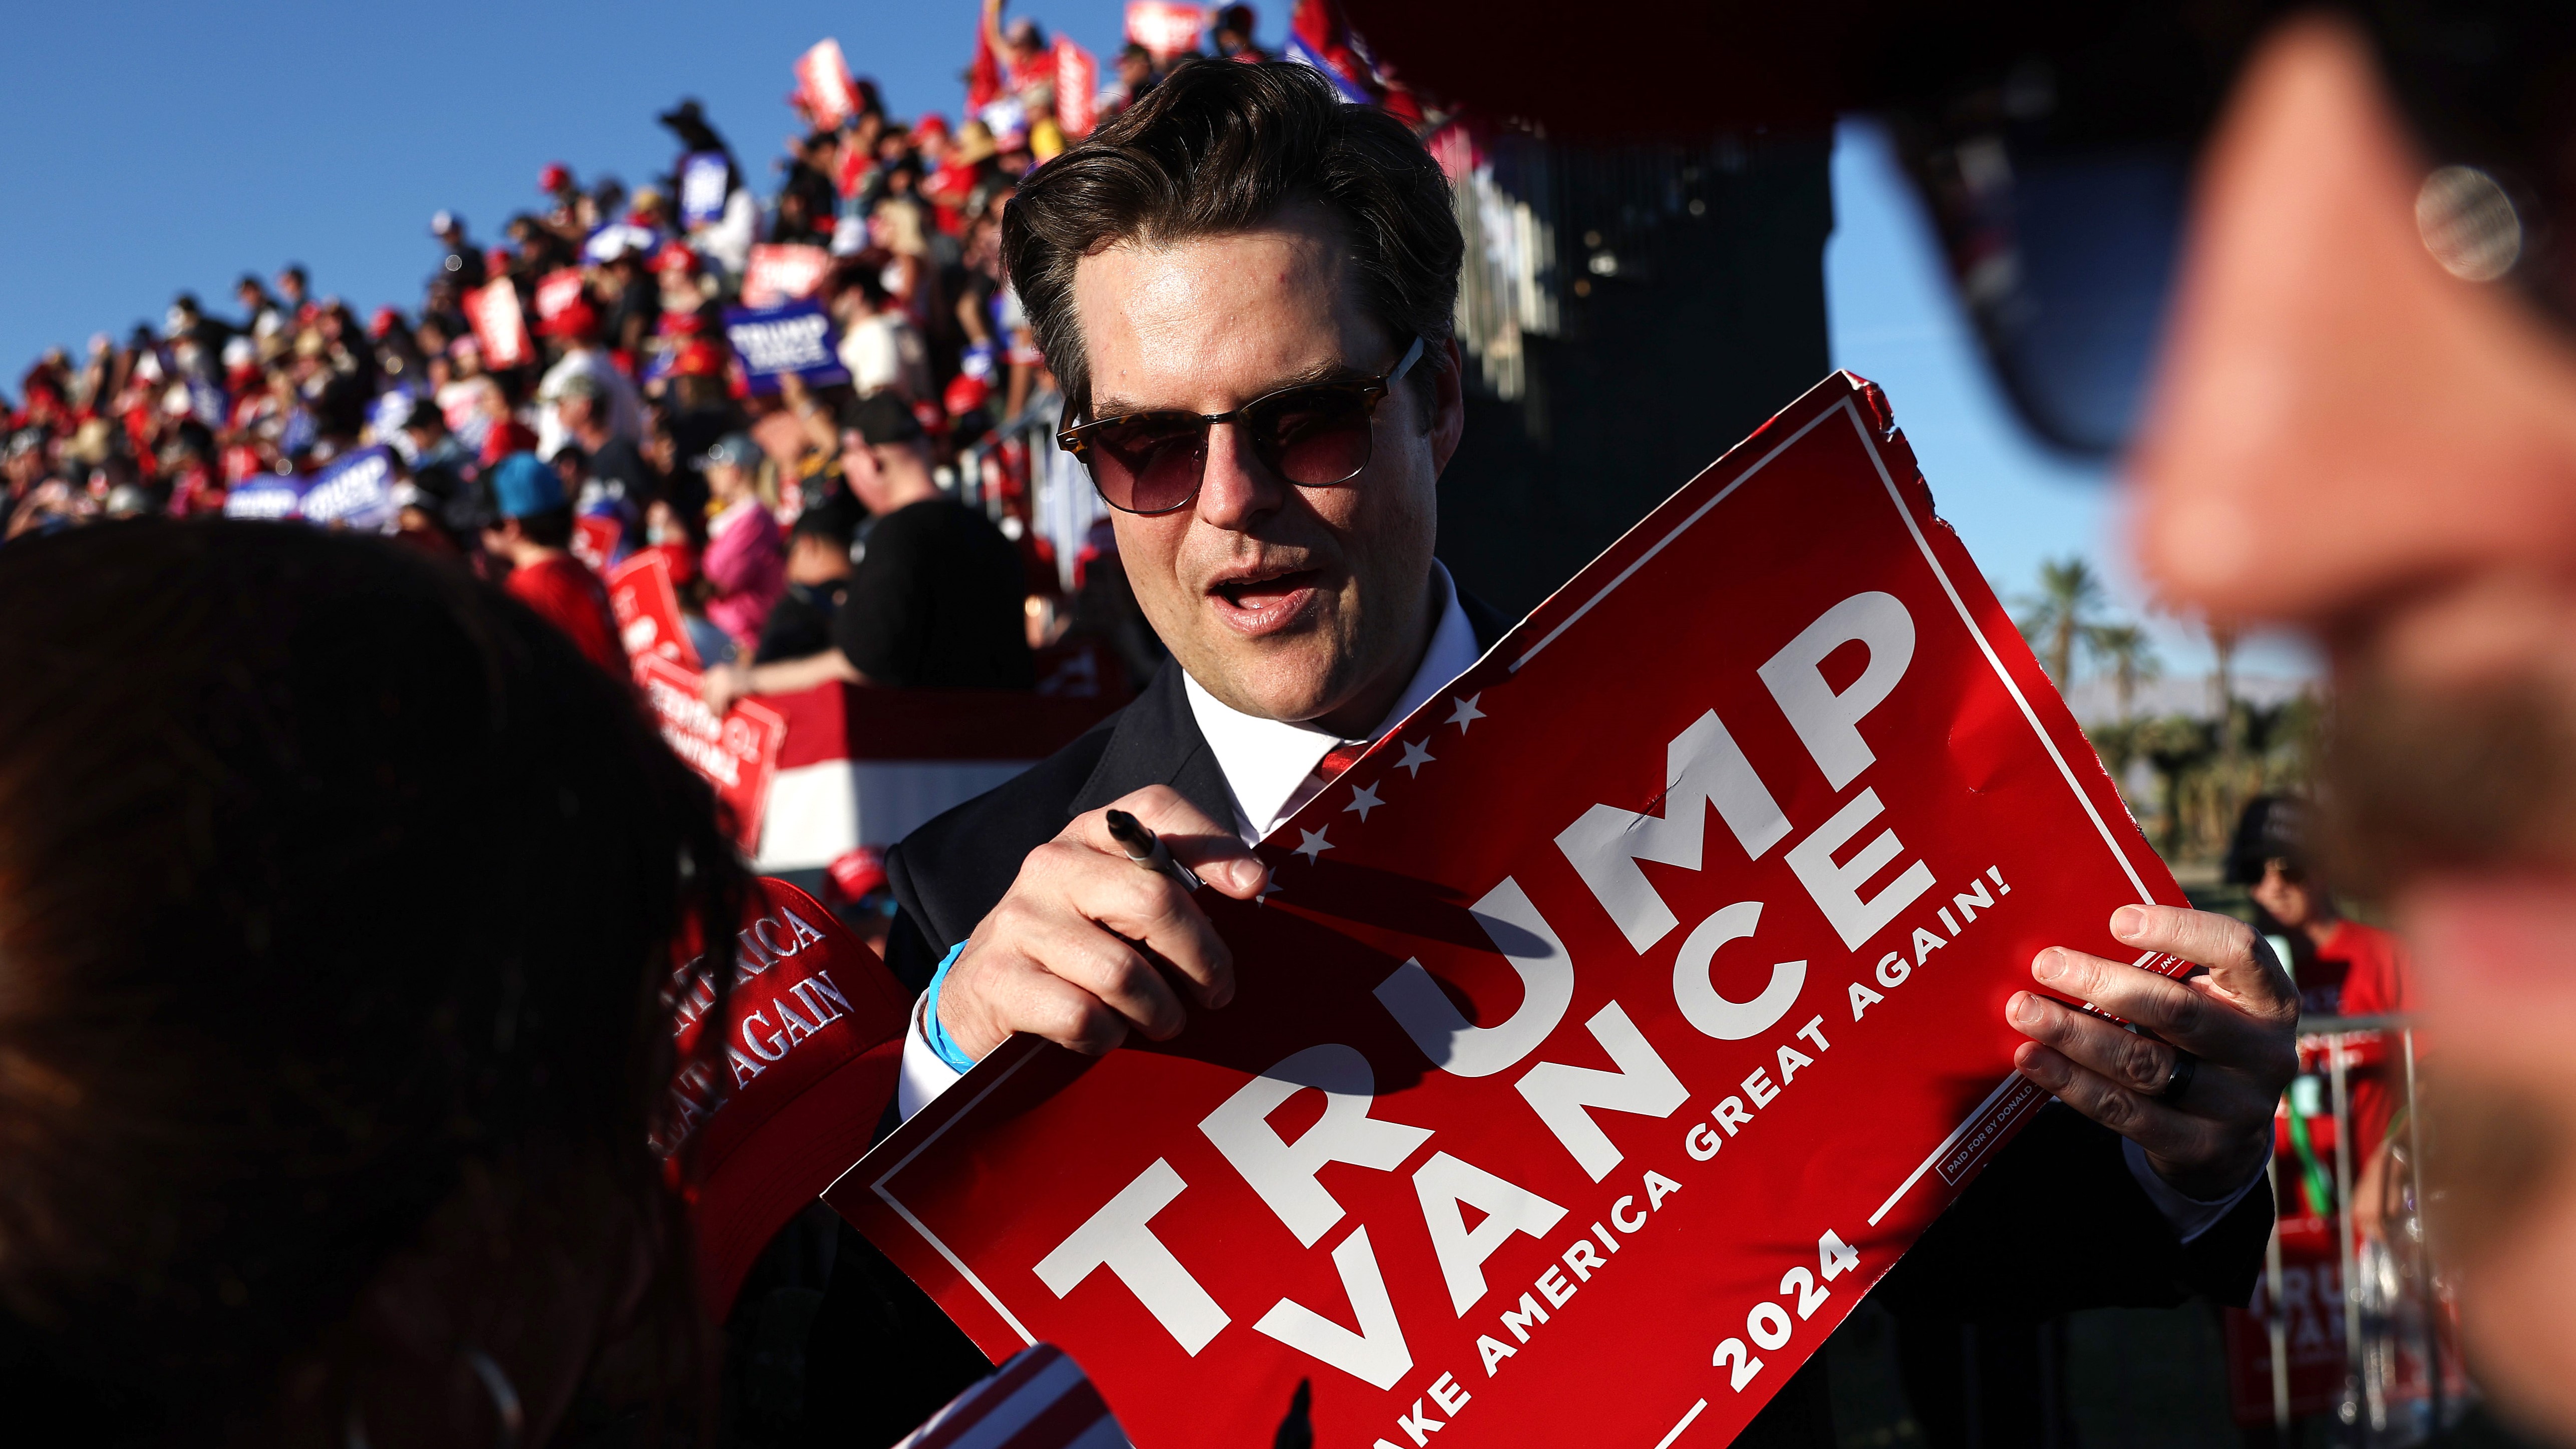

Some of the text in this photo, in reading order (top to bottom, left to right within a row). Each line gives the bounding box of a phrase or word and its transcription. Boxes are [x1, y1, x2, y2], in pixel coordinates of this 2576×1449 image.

[726, 970, 854, 1090] AGAIN
[1032, 591, 1915, 1357] TRUMP
[1252, 786, 1937, 1391] VANCE
[1476, 1170, 1682, 1378] AMERICA
[1686, 1014, 1830, 1161] GREAT
[1848, 865, 2011, 1022] AGAIN!
[1947, 1151, 1969, 1173] PAID
[1967, 1133, 1987, 1152] FOR
[1985, 1120, 1998, 1135] BY
[1997, 1085, 2032, 1122] DONALD
[1713, 1229, 1860, 1393] 2024
